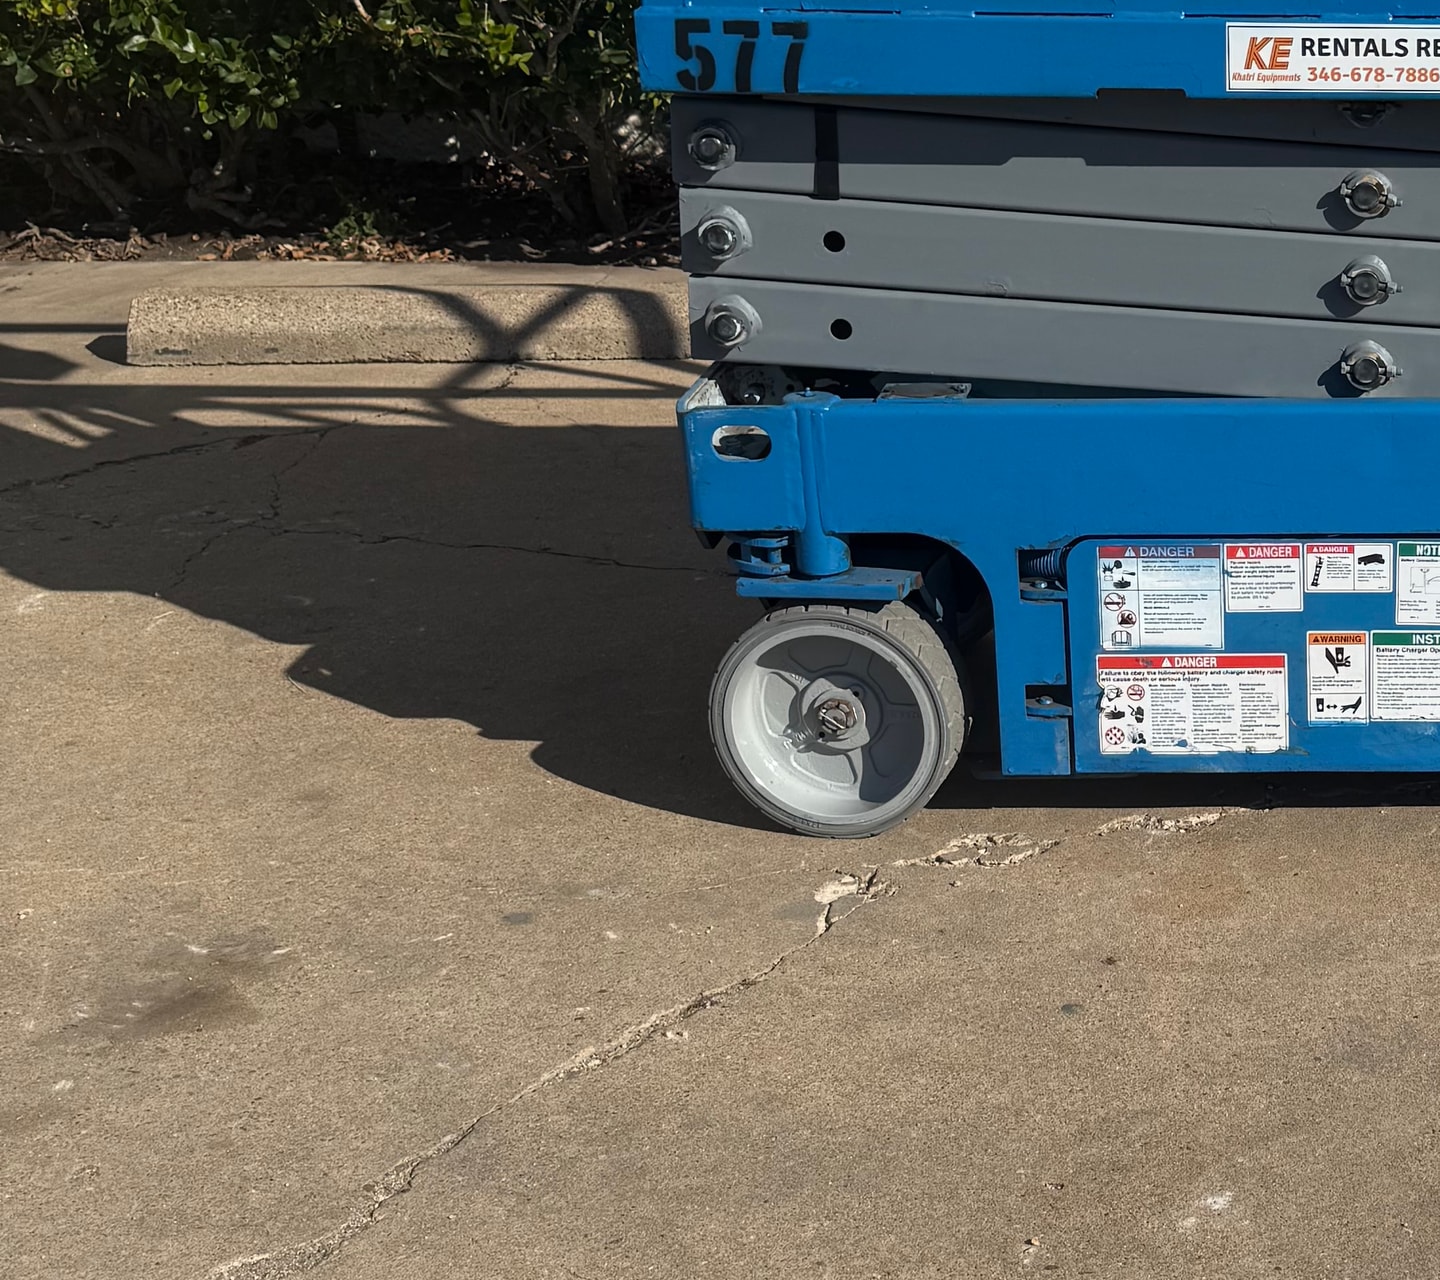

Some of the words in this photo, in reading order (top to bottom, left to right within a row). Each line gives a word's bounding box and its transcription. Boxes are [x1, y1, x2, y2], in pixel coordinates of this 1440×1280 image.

[1244, 37, 1294, 70] KE
[1301, 38, 1409, 57] RENTALS
[674, 18, 808, 93] 577
[1257, 72, 1301, 84] Equipments
[1307, 67, 1440, 82] 346-678-7886
[1140, 546, 1195, 557] DANGER
[1249, 546, 1292, 558] DANGER
[1174, 657, 1217, 668] DANGER
